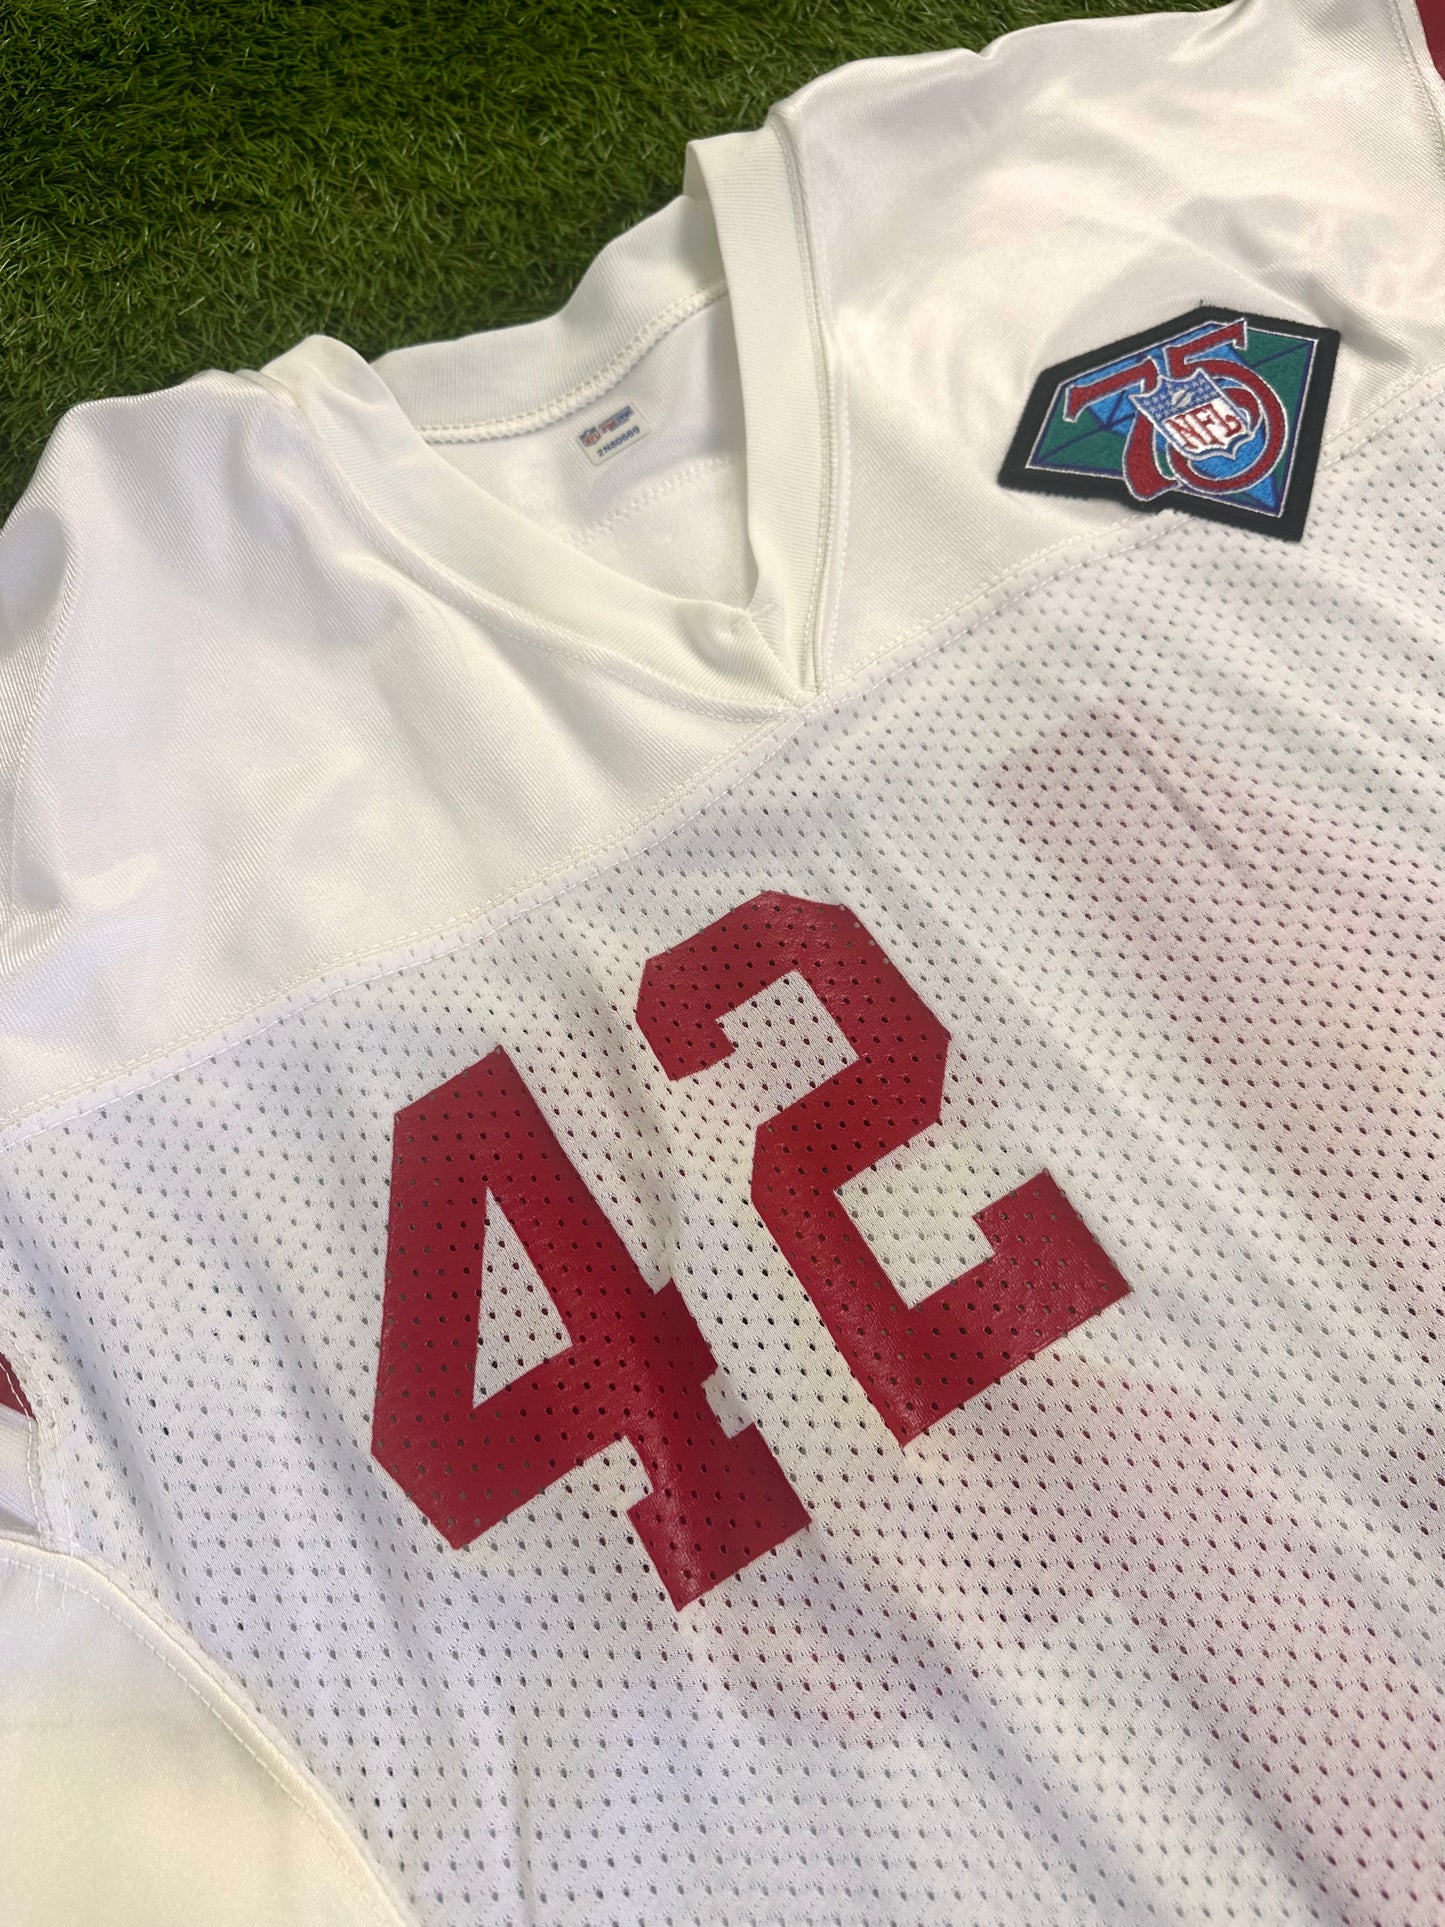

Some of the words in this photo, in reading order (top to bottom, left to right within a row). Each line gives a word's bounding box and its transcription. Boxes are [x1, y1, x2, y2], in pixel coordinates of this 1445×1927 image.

[1063, 317, 1288, 501] 75
[1165, 402, 1243, 450] NFL
[372, 891, 1129, 1611] 42
